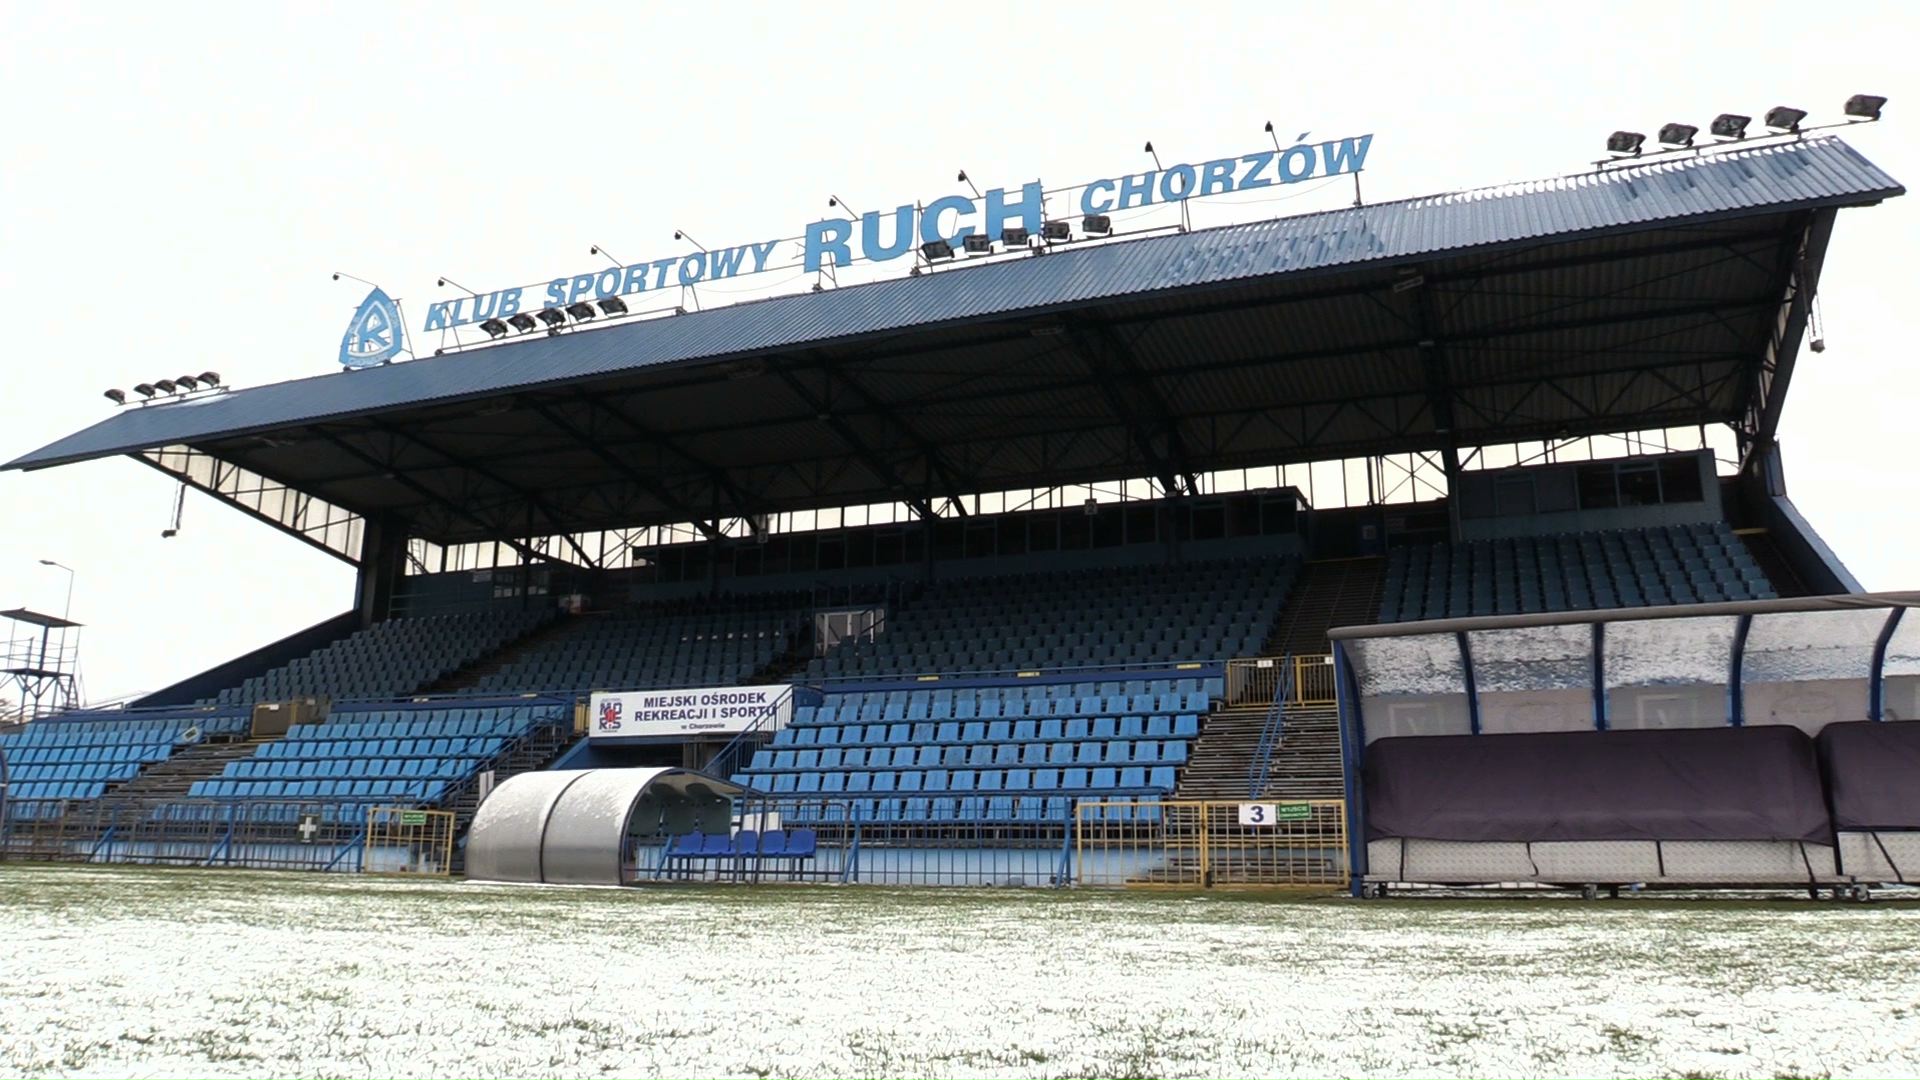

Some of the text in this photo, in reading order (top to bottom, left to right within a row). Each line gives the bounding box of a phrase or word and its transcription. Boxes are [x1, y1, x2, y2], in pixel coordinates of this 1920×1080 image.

[424, 131, 1374, 332] KLUB SPORTOWY RUCH CHORZÓW
[644, 692, 767, 708] MIEJSKI OŚRODEK
[635, 706, 777, 721] REKREACJI I SPORTU
[1250, 805, 1264, 823] 3
